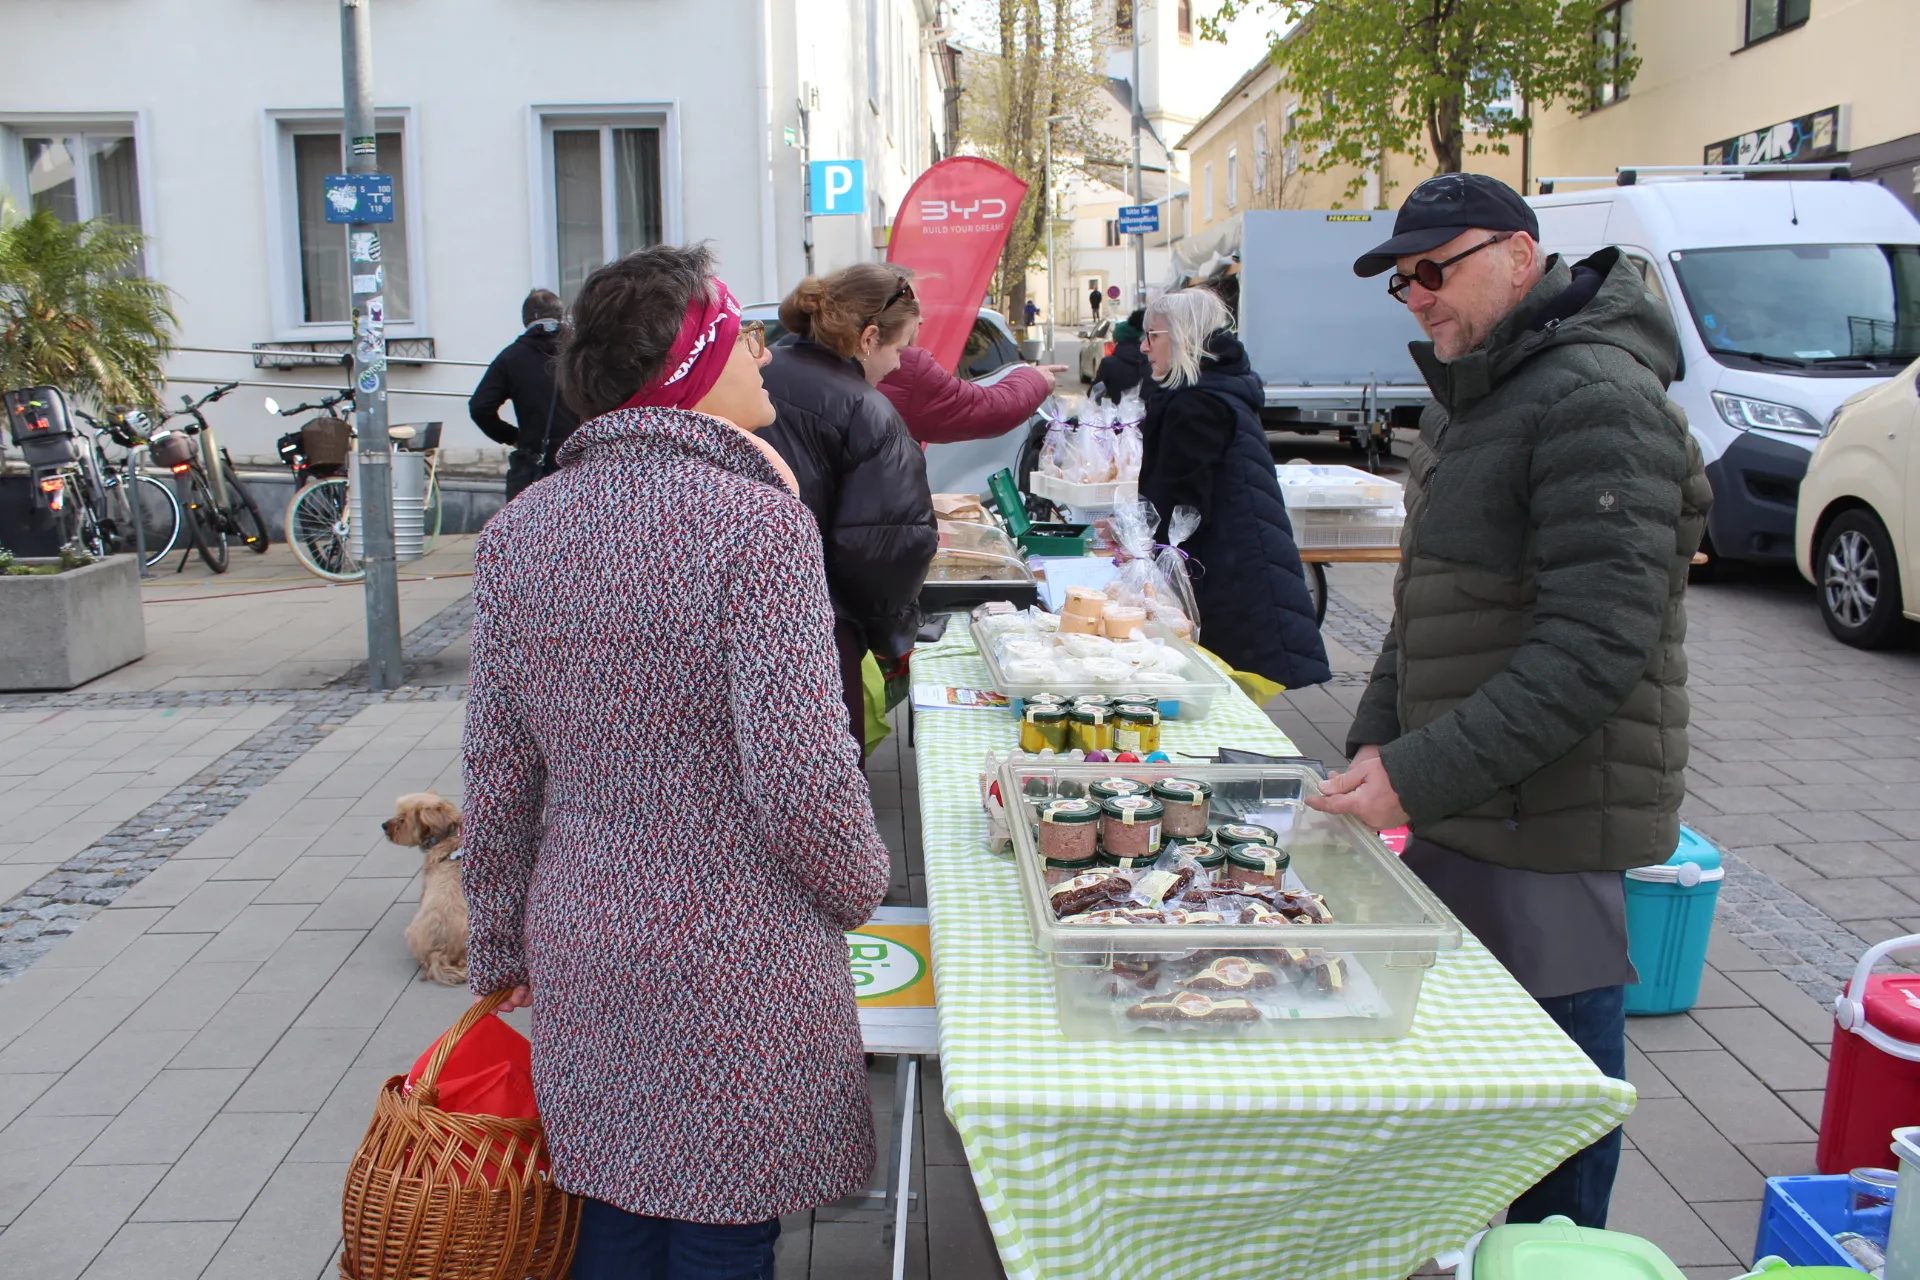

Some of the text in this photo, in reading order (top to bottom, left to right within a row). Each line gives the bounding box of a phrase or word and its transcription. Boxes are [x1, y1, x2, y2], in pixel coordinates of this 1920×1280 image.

[1738, 121, 1794, 166] BAR
[825, 165, 853, 210] P
[370, 205, 383, 213] 118
[921, 199, 1007, 220] BYD
[922, 223, 1004, 234] BUILD YOUR DREAMS
